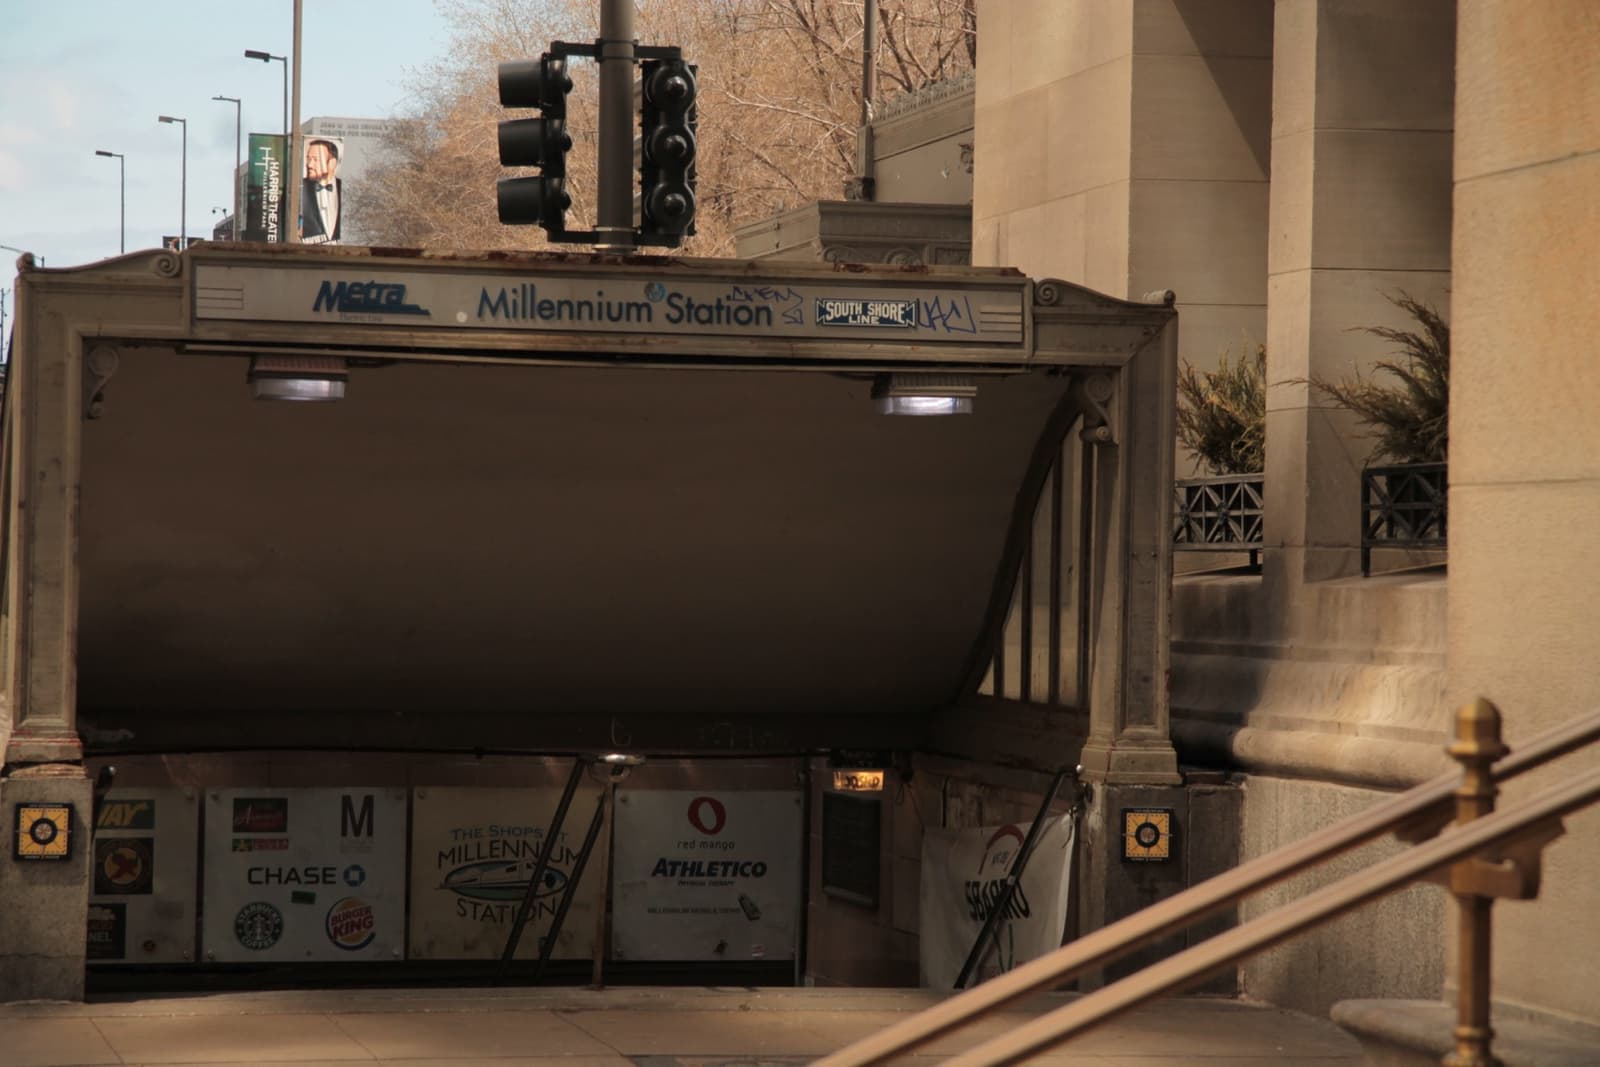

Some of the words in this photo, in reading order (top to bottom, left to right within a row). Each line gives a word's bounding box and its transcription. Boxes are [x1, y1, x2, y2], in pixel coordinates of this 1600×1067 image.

[269, 160, 280, 202] HARRIS
[313, 280, 408, 313] Metra
[477, 283, 652, 324] Millennium
[666, 291, 772, 327] Station
[826, 302, 863, 318] SOUTH
[867, 303, 907, 324] SHORE
[848, 315, 881, 325] LINE
[341, 795, 374, 837] M
[450, 828, 485, 840] THE
[488, 825, 544, 839] SHOPS
[676, 839, 696, 849] red
[699, 840, 736, 852] mango
[247, 867, 337, 885] CHASE
[651, 858, 768, 878] ATHLETICO
[237, 902, 283, 925] STARBUCKS
[330, 905, 373, 927] BURGER
[332, 915, 375, 939] KING
[240, 936, 277, 950] COFFEE
